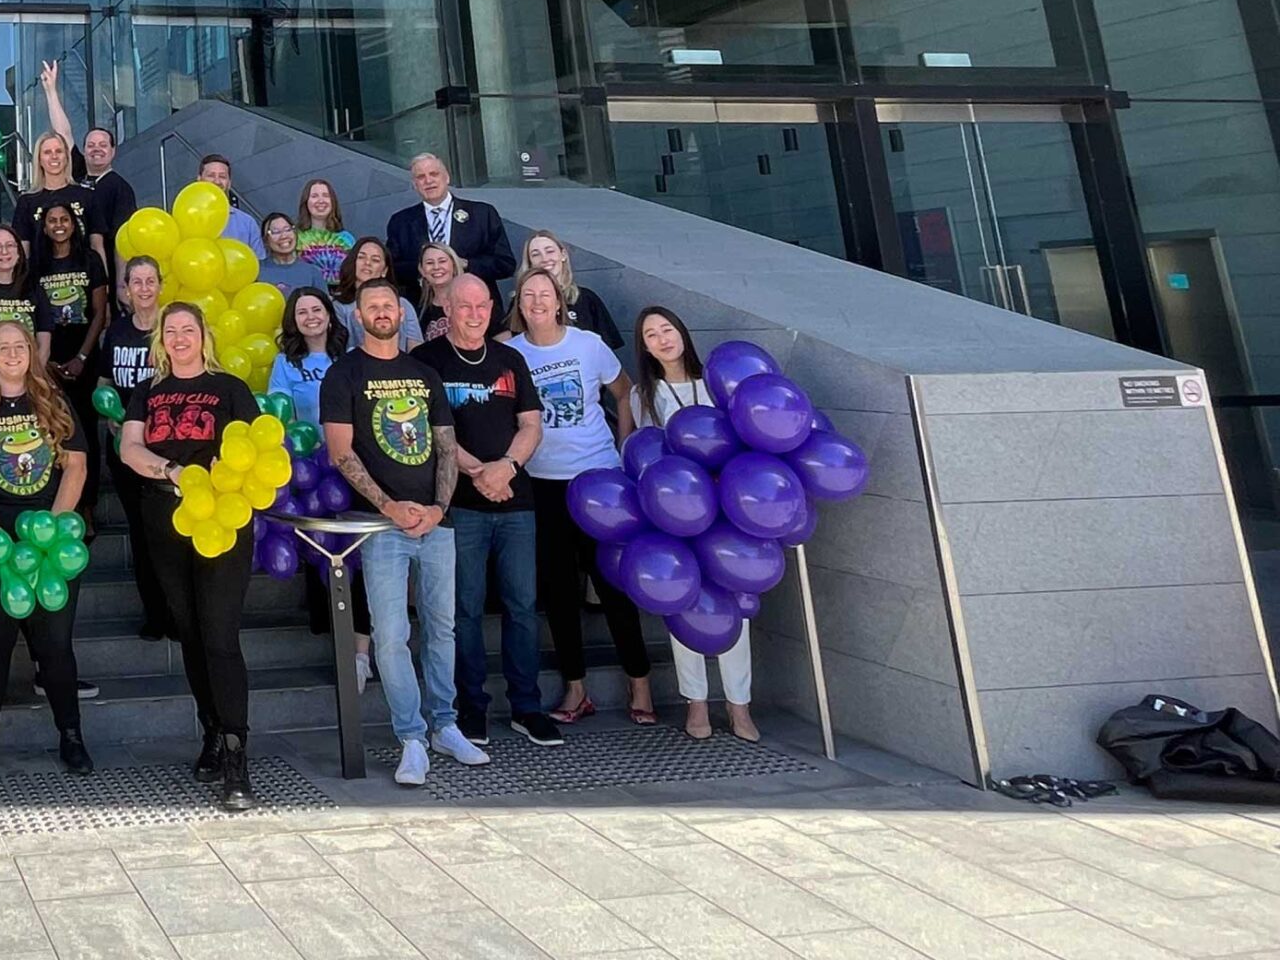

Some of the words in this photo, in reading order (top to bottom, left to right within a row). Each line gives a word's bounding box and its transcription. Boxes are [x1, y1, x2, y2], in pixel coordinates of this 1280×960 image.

[114, 346, 148, 367] DON'T
[113, 367, 135, 388] LIVE
[367, 379, 425, 390] AUSMUSIC
[364, 389, 407, 400] T-SHIRT
[410, 388, 430, 398] DAY
